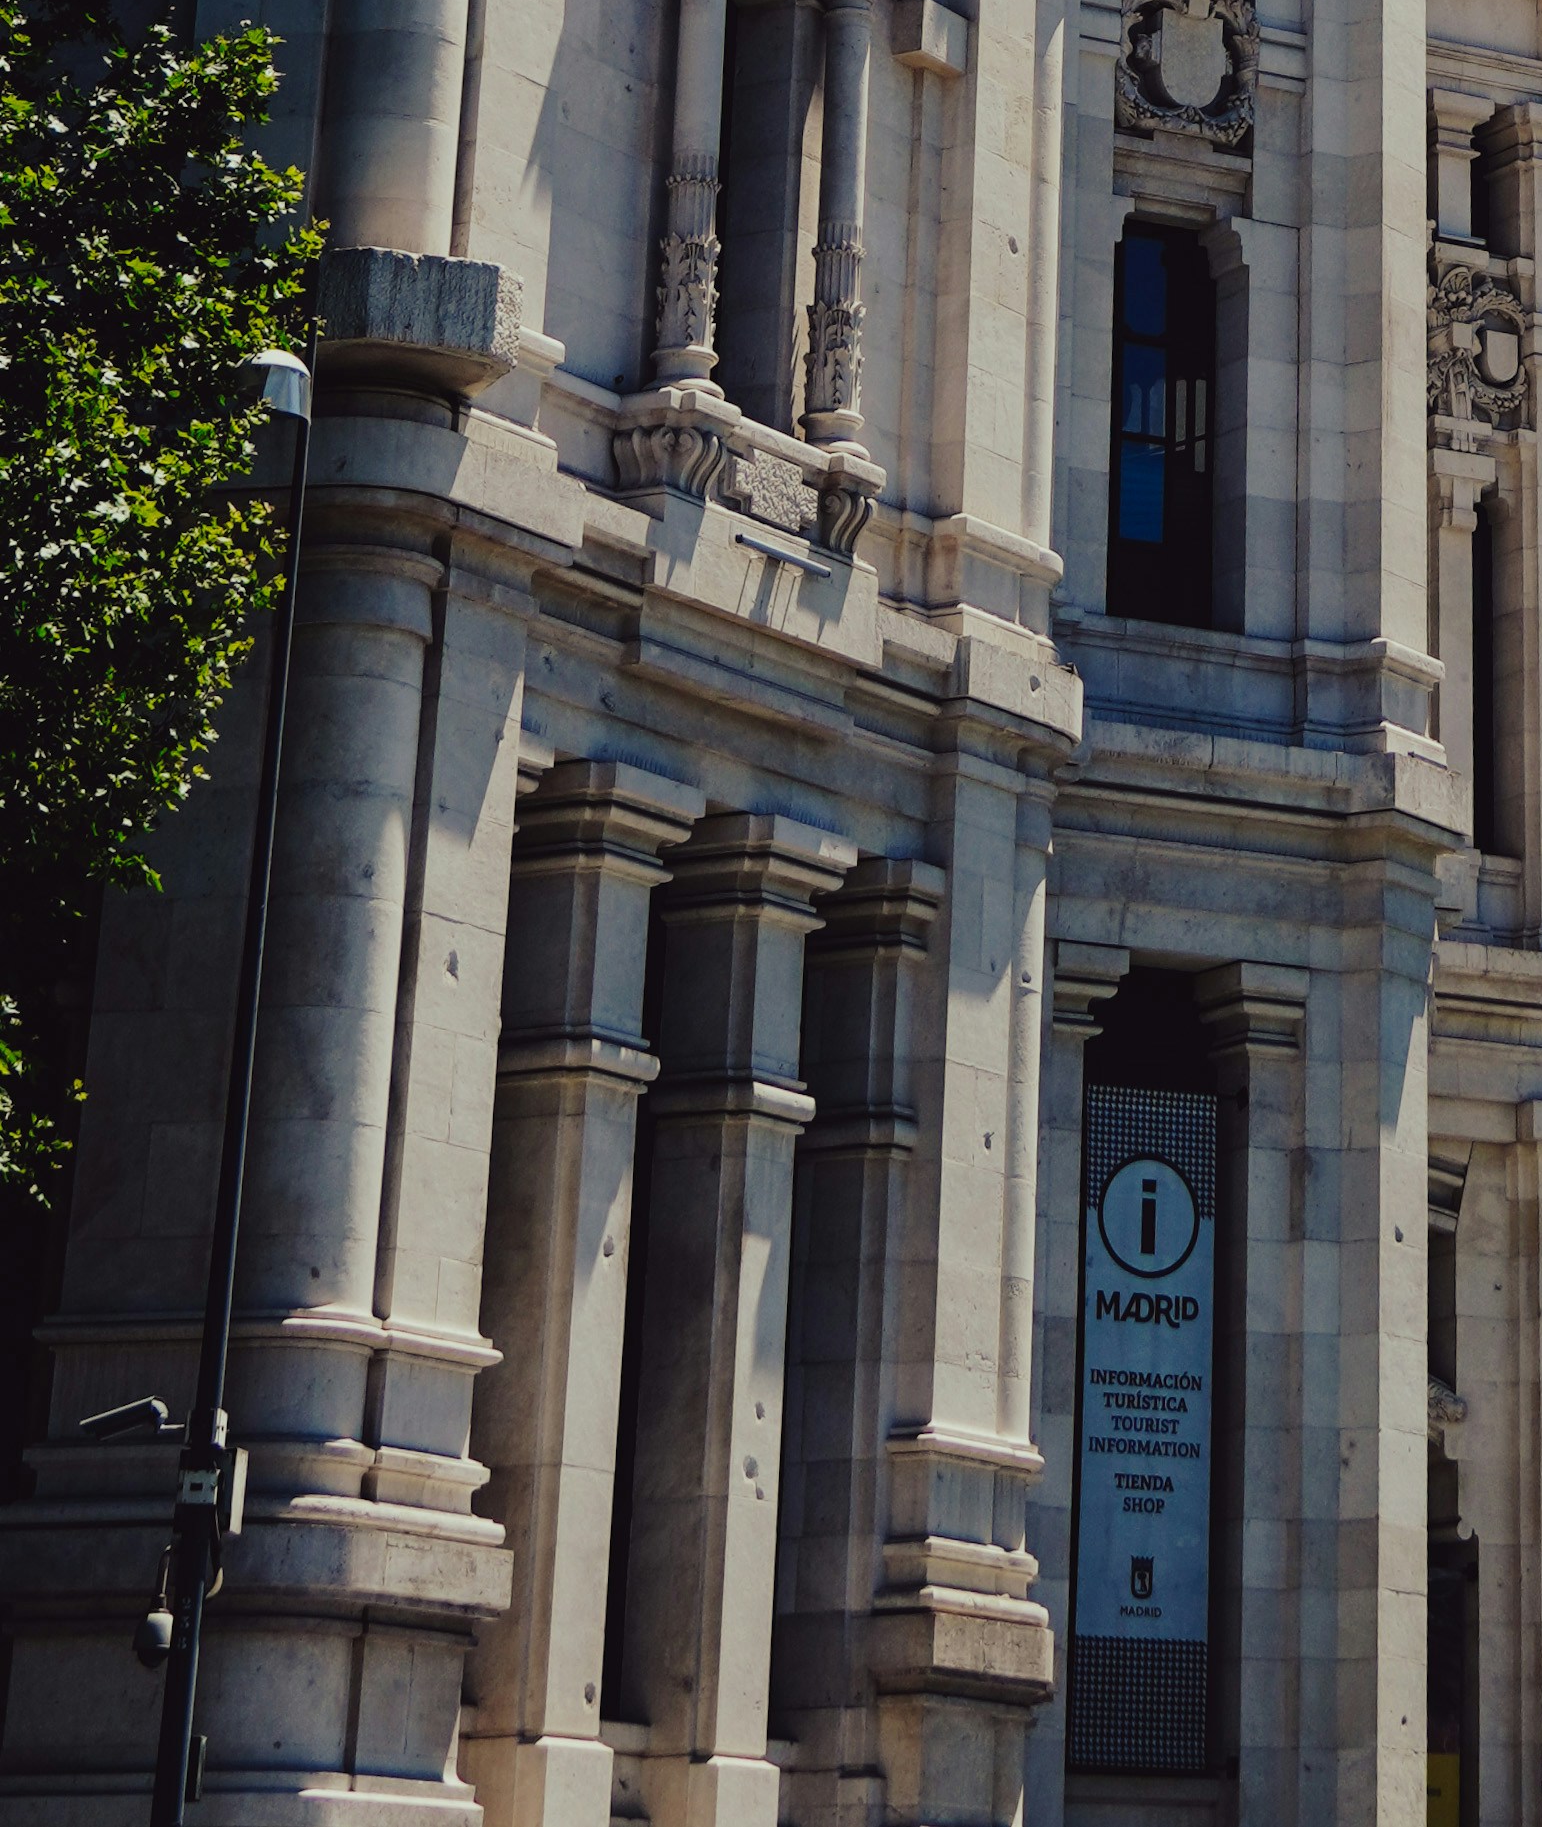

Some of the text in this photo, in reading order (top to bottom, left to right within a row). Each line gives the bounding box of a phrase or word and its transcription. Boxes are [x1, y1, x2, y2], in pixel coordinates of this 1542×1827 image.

[1096, 1289, 1199, 1329] MADRID
[1089, 1367, 1203, 1392] INFORMACIÓN
[1103, 1390, 1188, 1413] TURÍSTICA
[1111, 1415, 1180, 1435] TOURIST
[1088, 1436, 1201, 1458] INFORMATION
[1114, 1472, 1174, 1492] TIENDA
[1122, 1496, 1165, 1514] SHOP
[1120, 1605, 1162, 1618] MADRID
